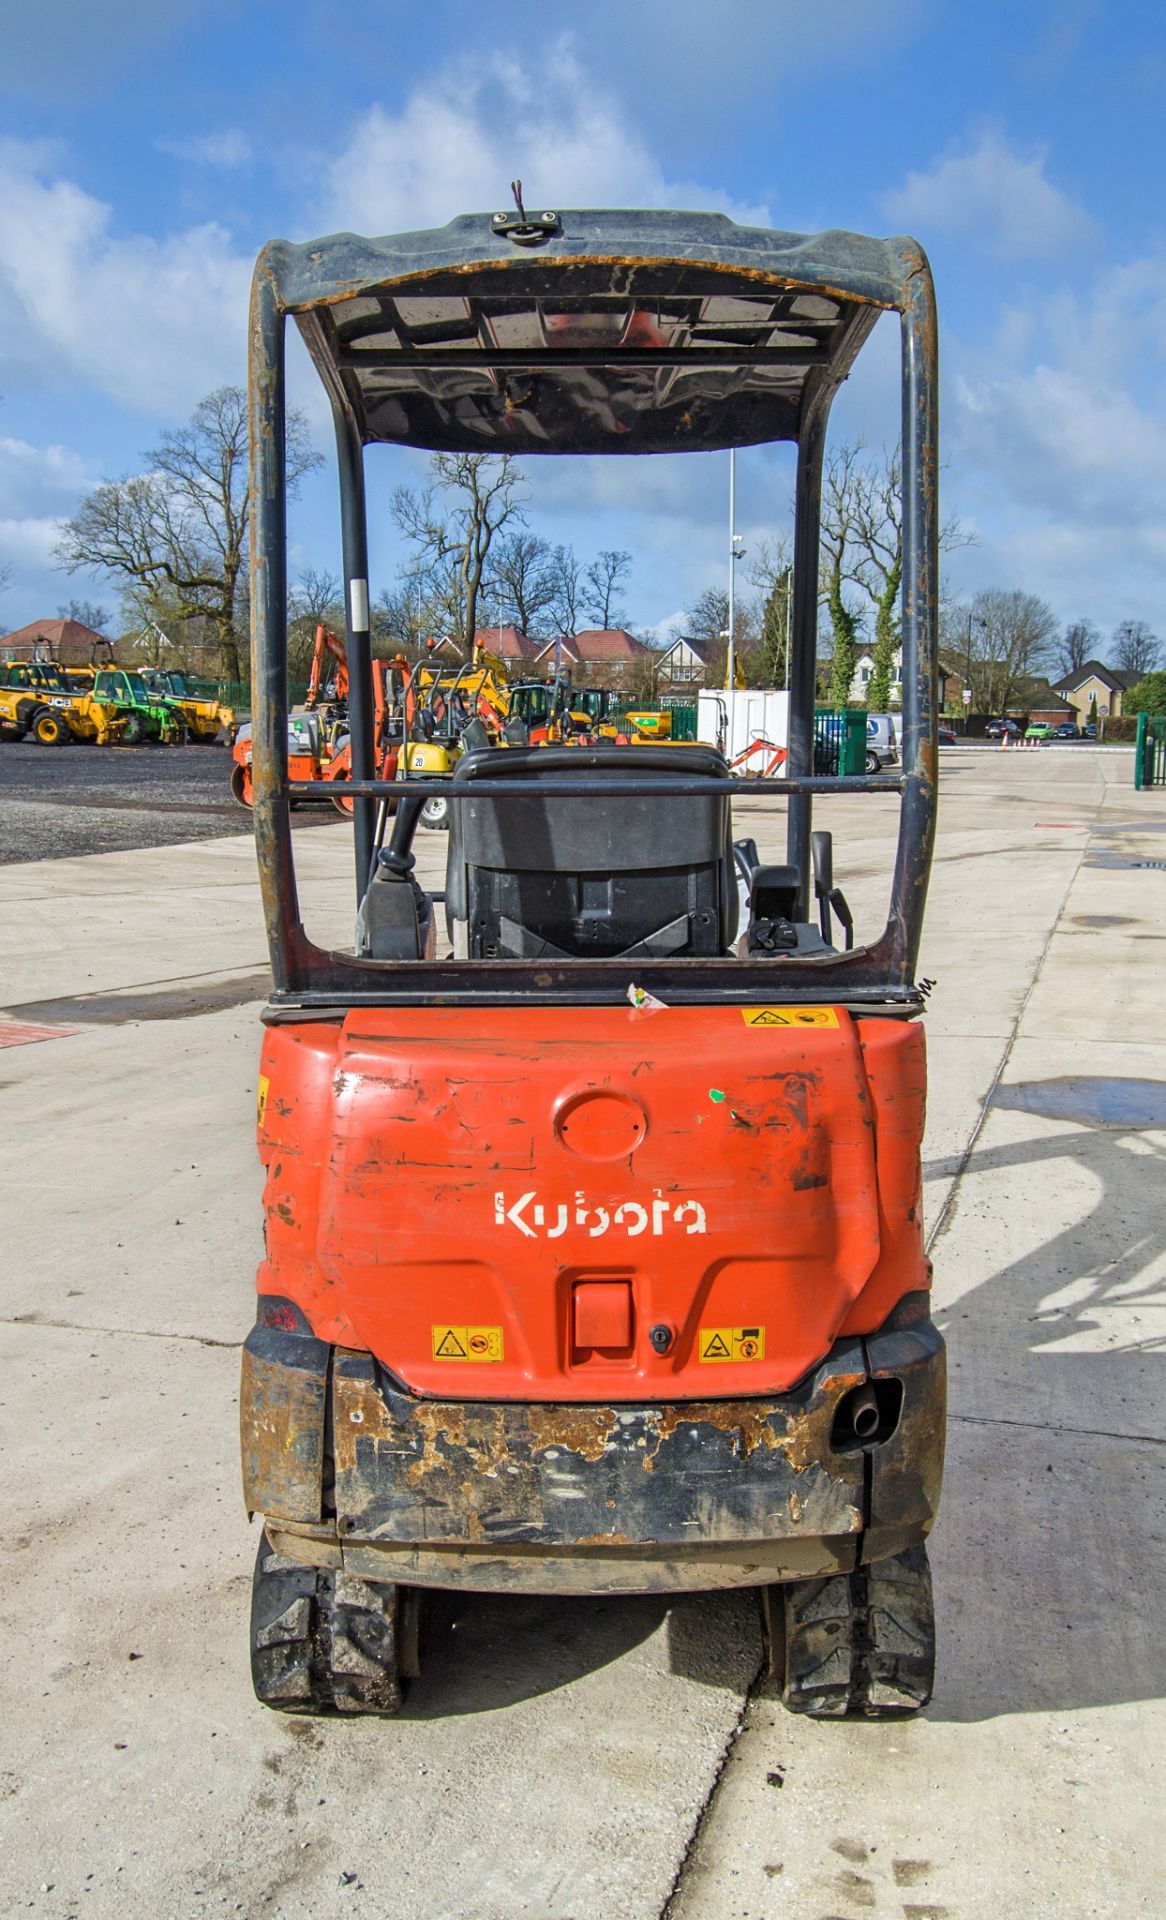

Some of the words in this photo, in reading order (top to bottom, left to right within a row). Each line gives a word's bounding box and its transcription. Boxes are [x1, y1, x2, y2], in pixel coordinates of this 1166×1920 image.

[47, 697, 72, 707] JCB
[415, 757, 423, 767] 20
[494, 1188, 707, 1238] Kubota
